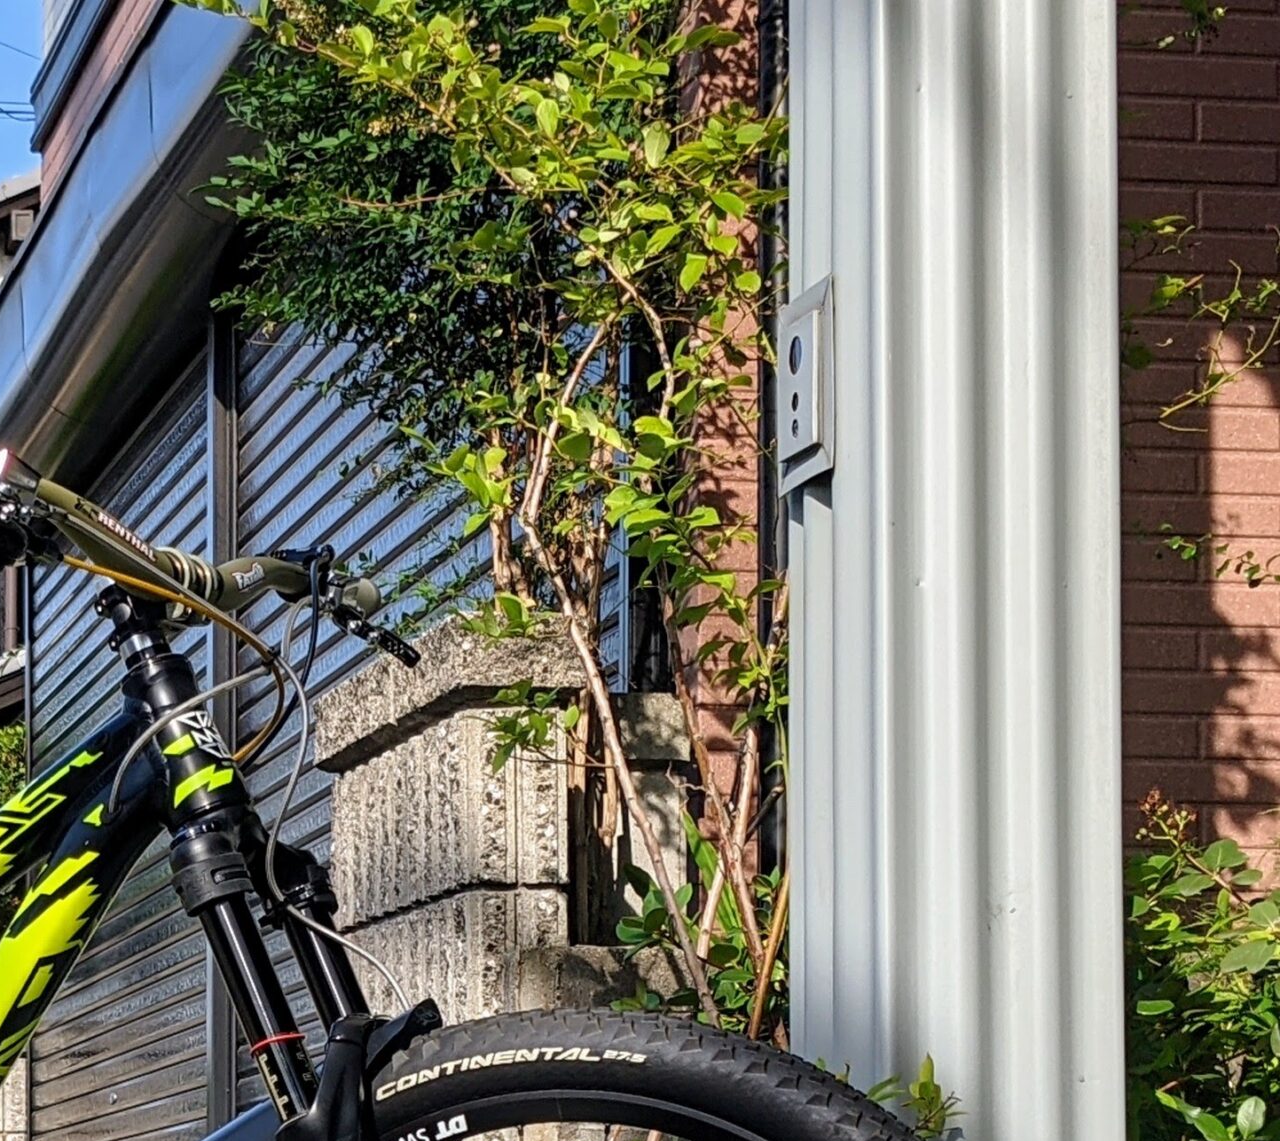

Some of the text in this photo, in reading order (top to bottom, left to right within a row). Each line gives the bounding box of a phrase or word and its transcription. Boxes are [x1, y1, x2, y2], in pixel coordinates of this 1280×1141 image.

[97, 511, 157, 562] RENTHAL
[375, 1046, 648, 1101] CONTINENTAL 27.5
[434, 1113, 469, 1141] DT
